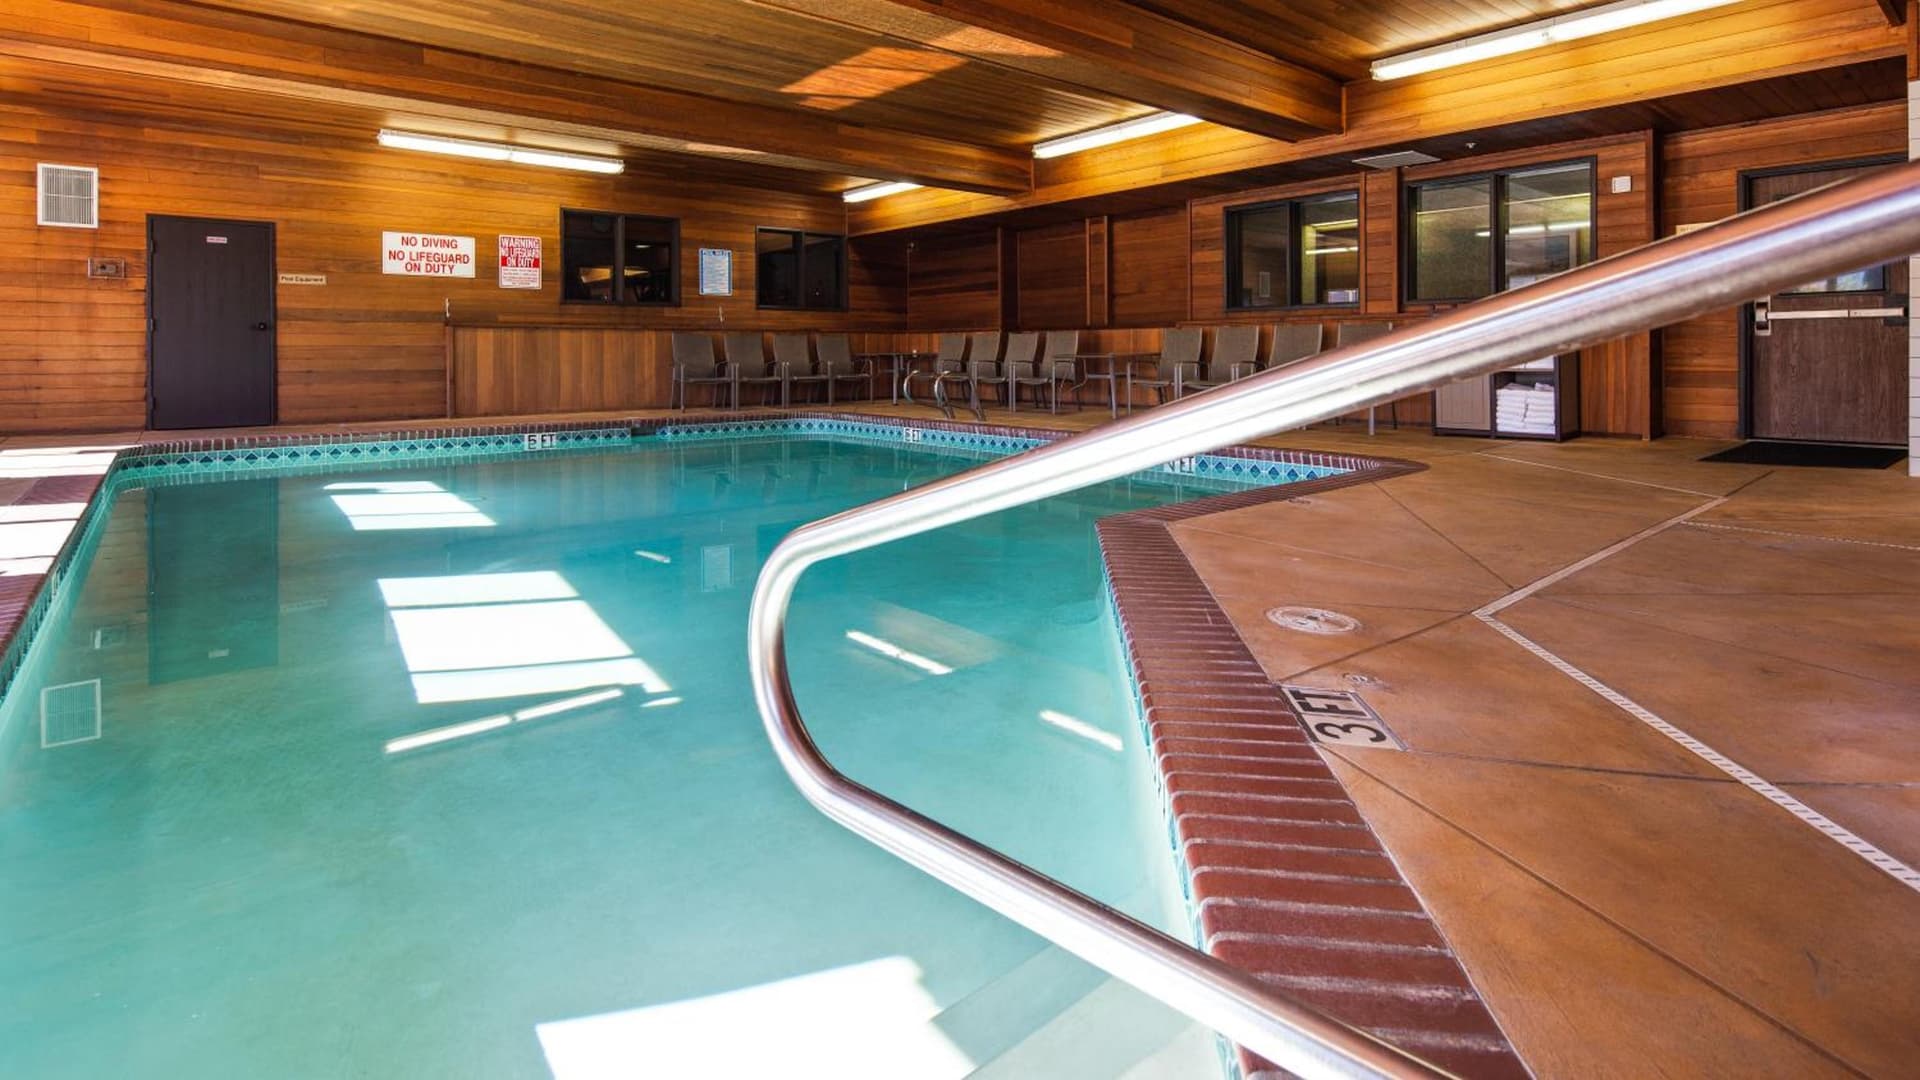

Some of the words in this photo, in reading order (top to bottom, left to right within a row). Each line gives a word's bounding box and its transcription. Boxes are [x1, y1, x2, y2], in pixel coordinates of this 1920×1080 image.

[401, 236, 418, 247] NO
[422, 237, 458, 249] DIVING
[388, 250, 405, 261] NO
[409, 251, 470, 264] LIFEGUARD
[405, 262, 420, 273] ON
[425, 263, 455, 274] DUTY
[528, 434, 537, 449] 5
[541, 434, 555, 448] FT
[1288, 689, 1368, 717] FT
[1314, 722, 1387, 743] 3
